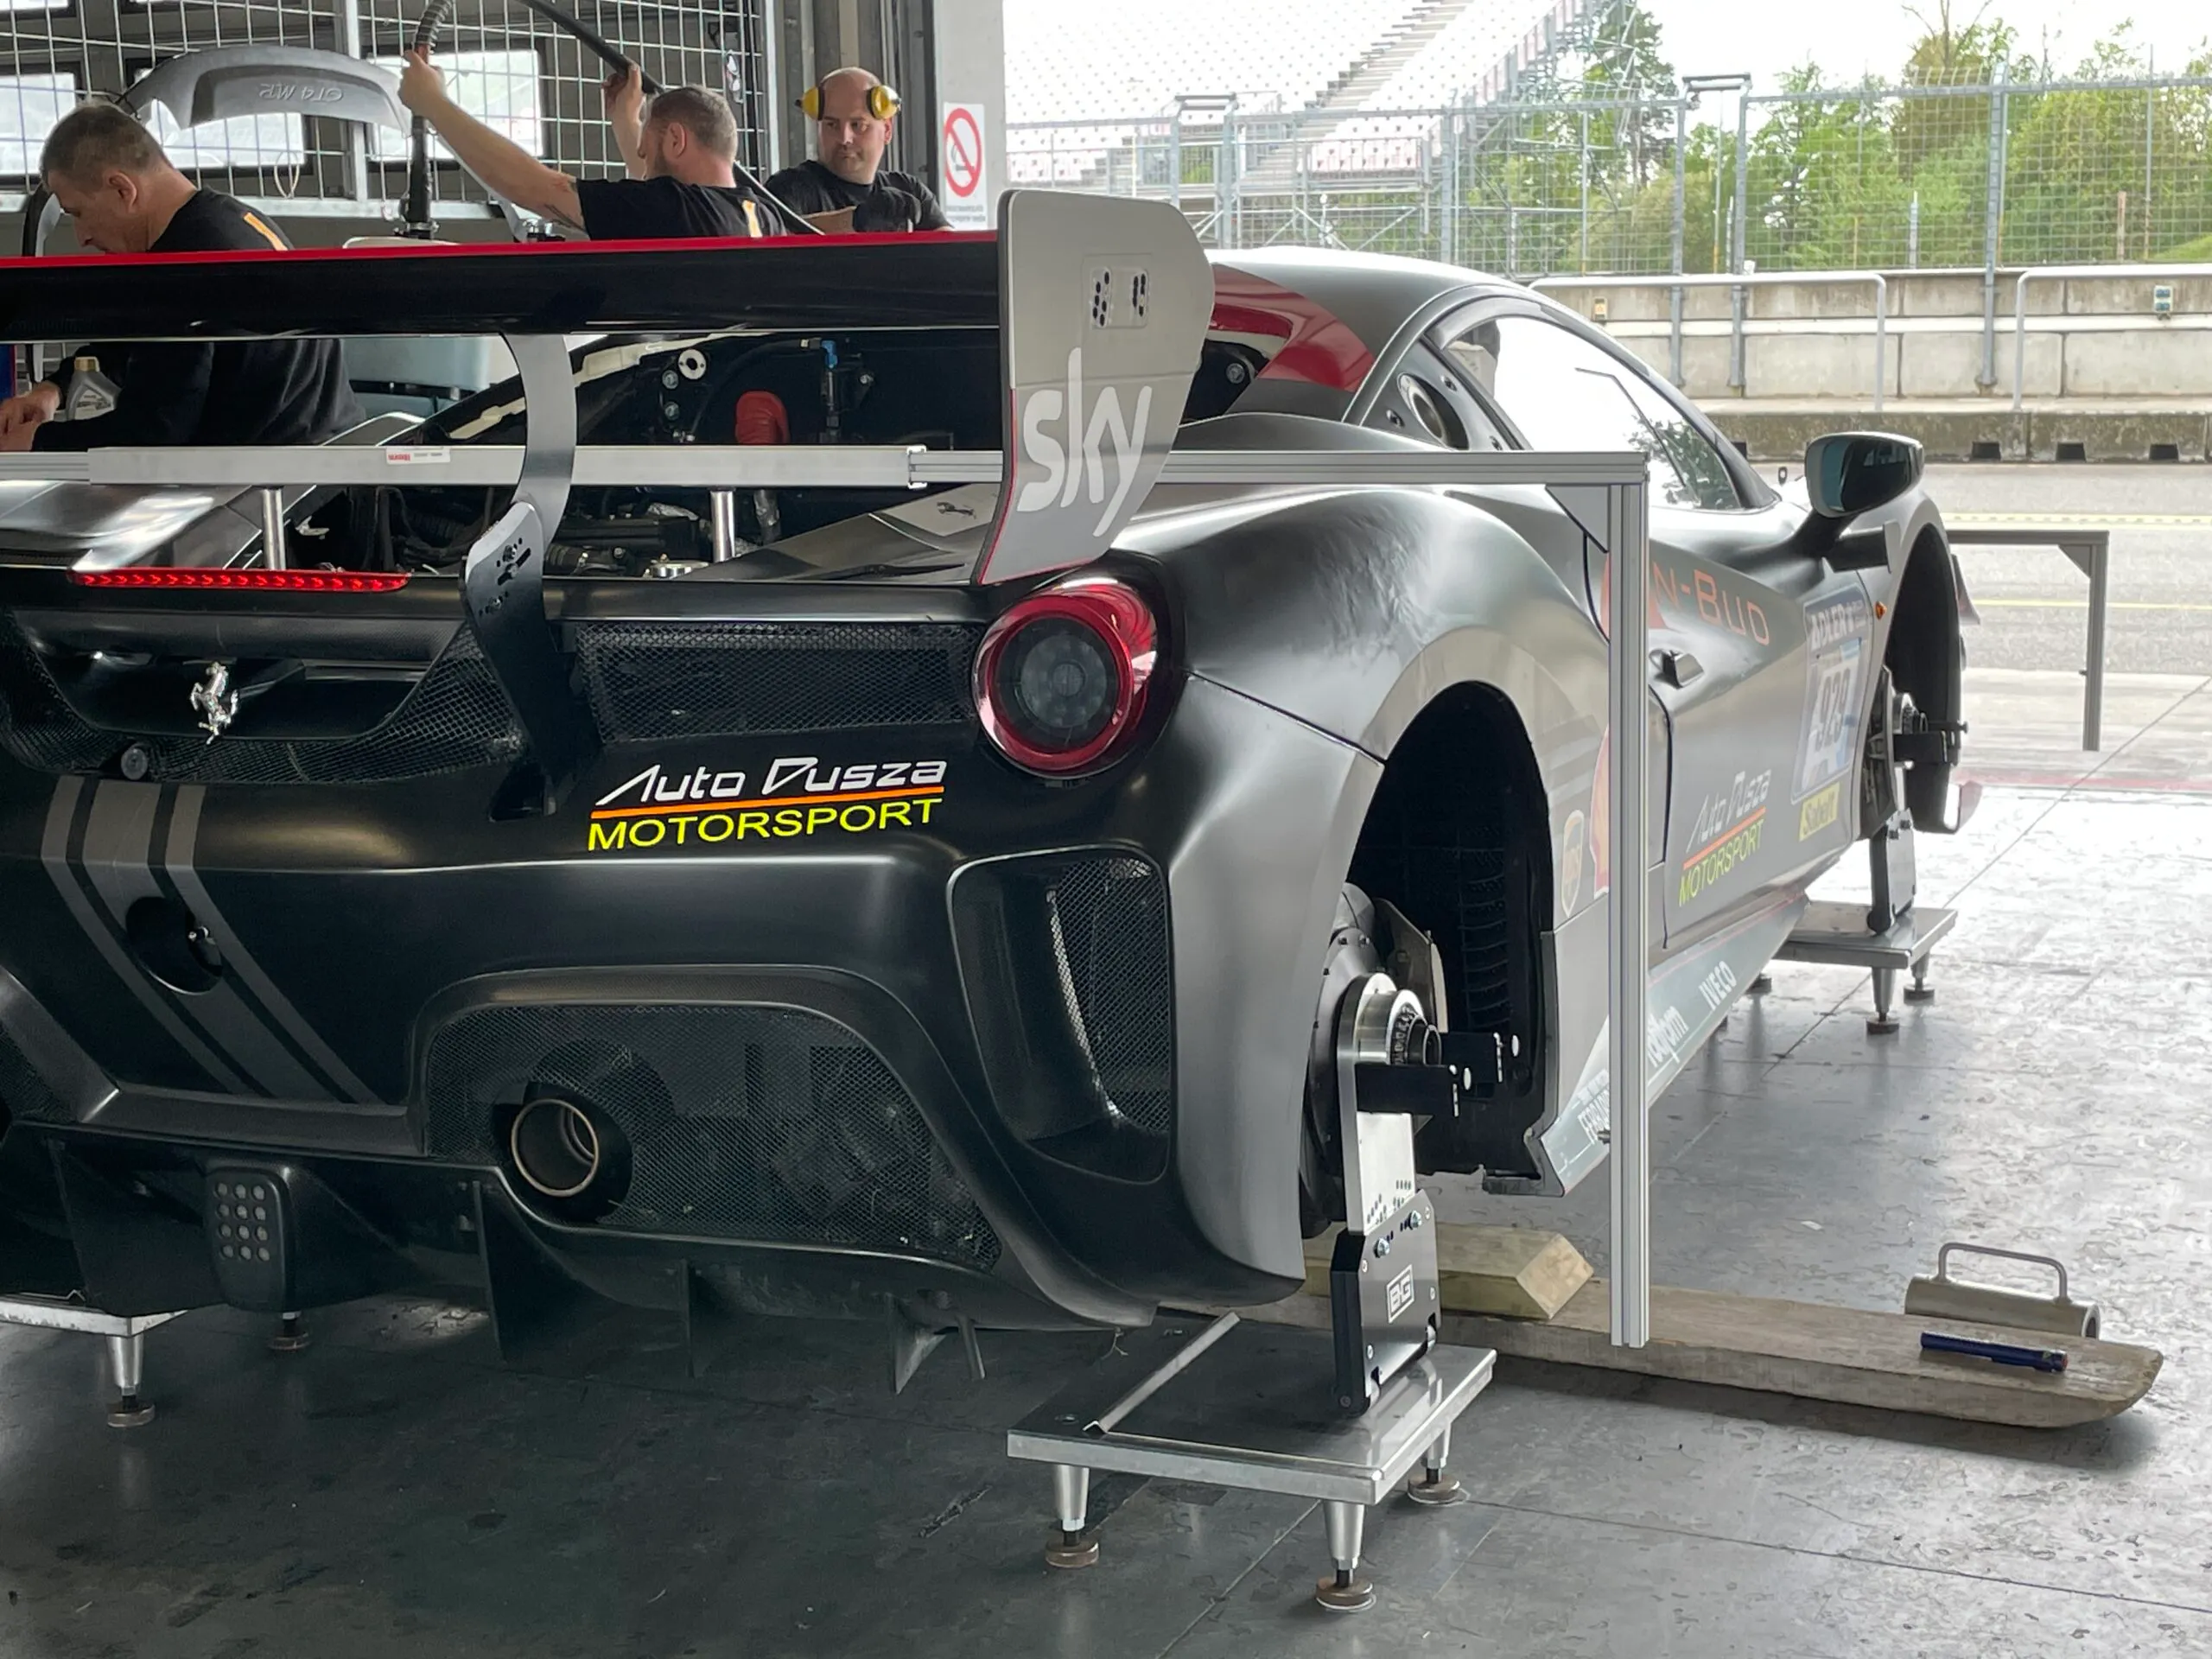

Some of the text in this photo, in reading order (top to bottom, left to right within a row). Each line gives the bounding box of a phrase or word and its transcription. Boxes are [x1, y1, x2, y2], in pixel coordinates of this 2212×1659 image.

[1016, 347, 1152, 537] sky
[1653, 561, 1769, 645] N-BUD
[596, 756, 947, 806] Auto Dusza
[588, 798, 943, 851] MOTORSPORT
[1679, 819, 1764, 906] MOTORSPORT
[1698, 960, 1737, 1011] IVECO
